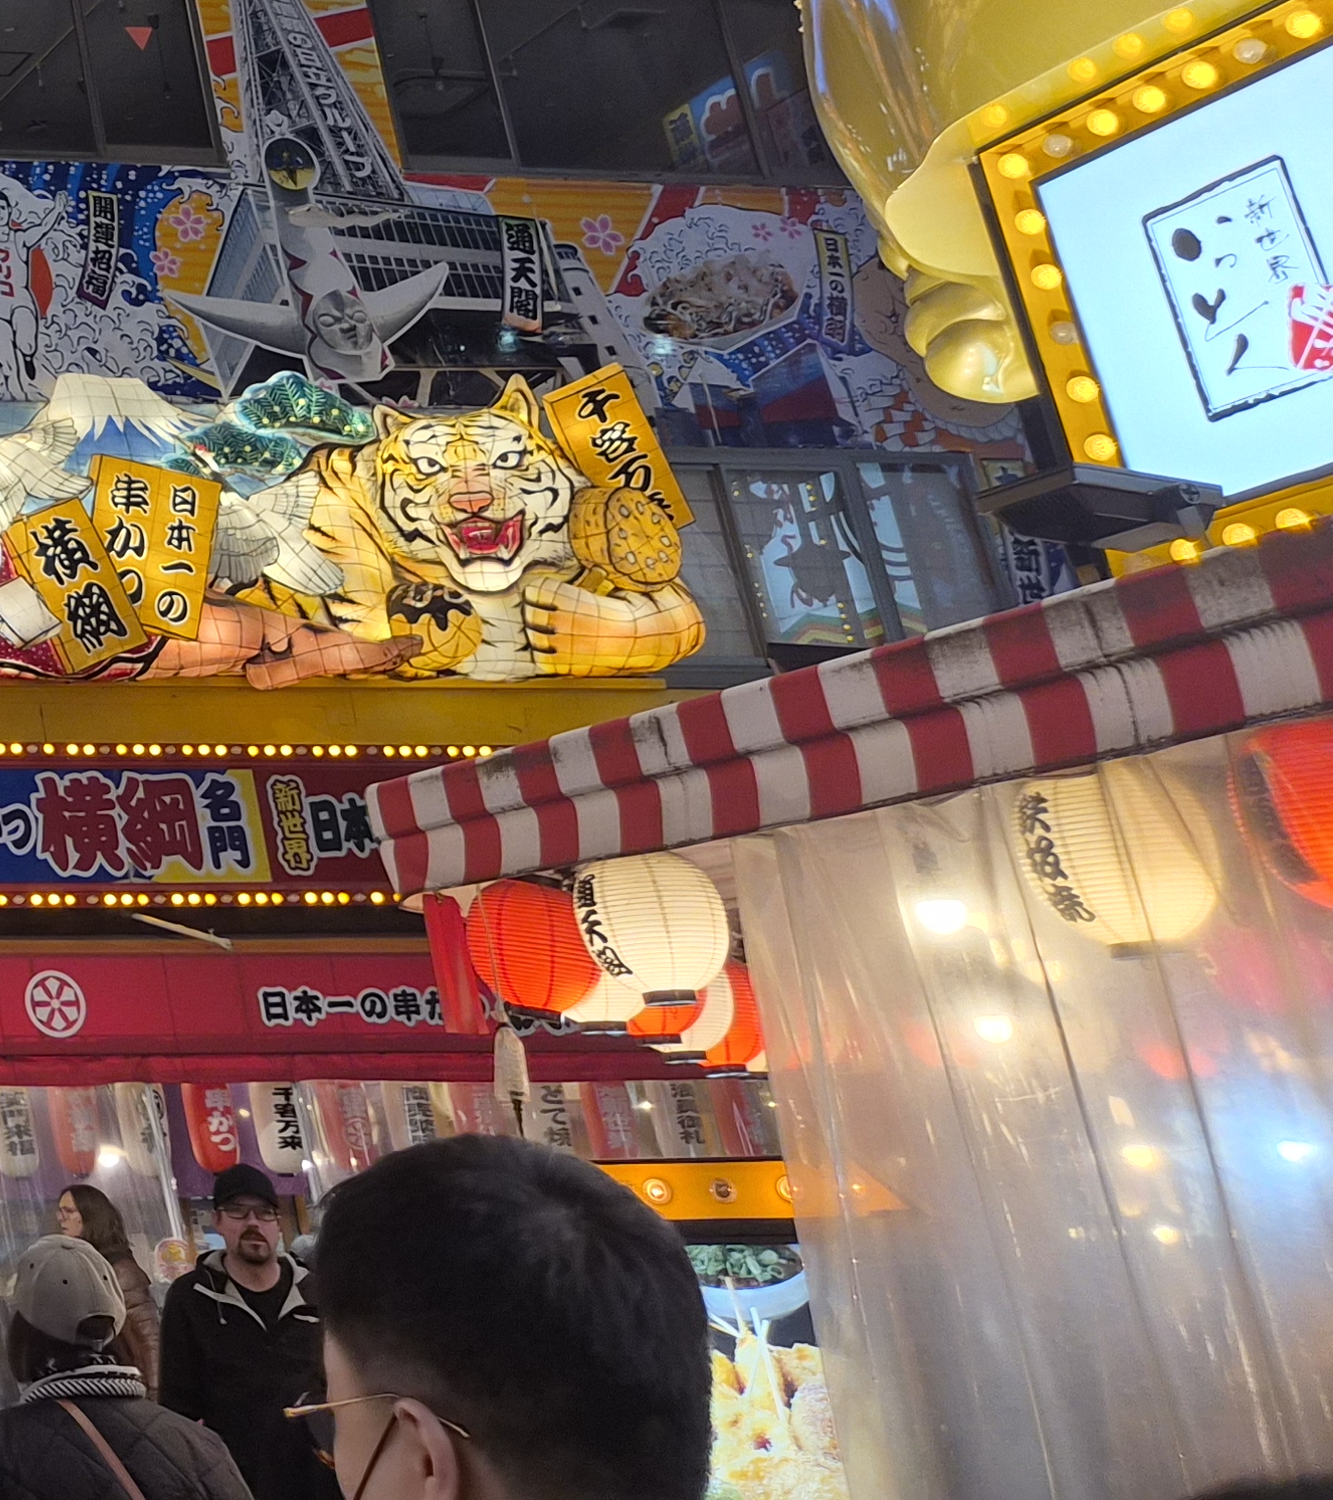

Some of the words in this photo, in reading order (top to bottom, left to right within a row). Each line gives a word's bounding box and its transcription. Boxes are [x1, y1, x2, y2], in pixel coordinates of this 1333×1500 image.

[504, 220, 539, 320] 通天閣
[577, 389, 675, 523] 千客万
[33, 518, 128, 651] 横綱
[156, 485, 200, 623] 日本一の
[37, 775, 205, 876] 横綱
[202, 778, 251, 872] 名門
[274, 780, 314, 874] 新世界
[204, 1089, 238, 1153] 串かつ
[271, 1087, 304, 1151] 千客万来
